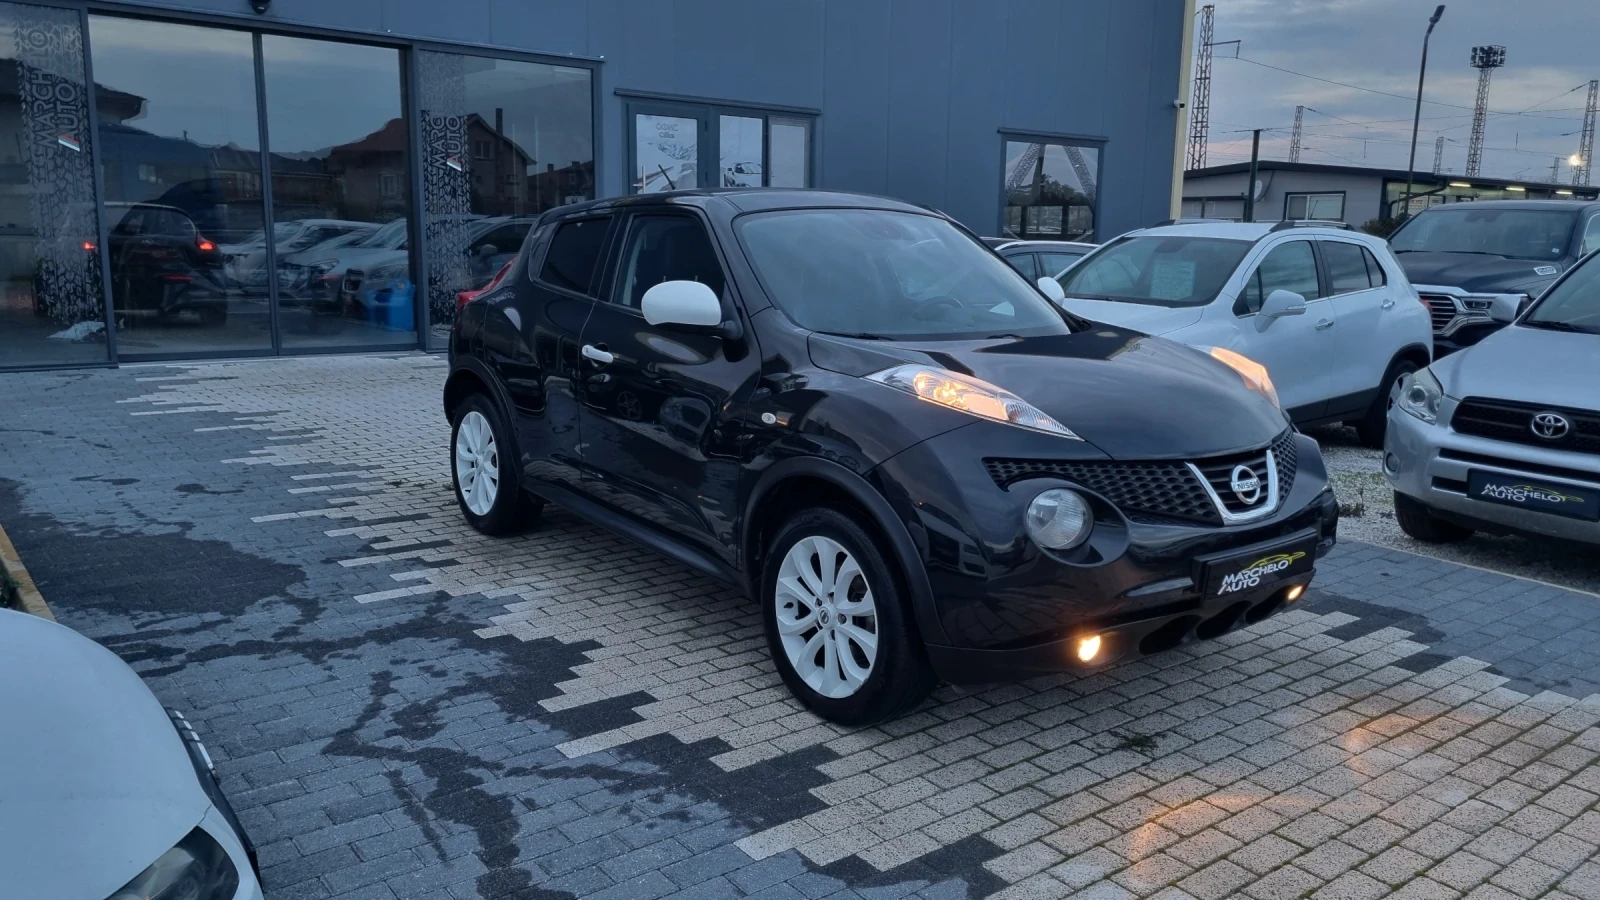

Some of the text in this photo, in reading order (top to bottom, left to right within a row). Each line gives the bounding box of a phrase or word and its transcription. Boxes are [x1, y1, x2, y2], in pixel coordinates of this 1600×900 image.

[55, 83, 80, 151] AUTO
[446, 115, 462, 171] AUTO
[1481, 489, 1526, 502] AUTO
[1485, 483, 1561, 503] MARCHELO
[1221, 560, 1289, 586] MARCHELO
[1217, 577, 1260, 595] AUTO
